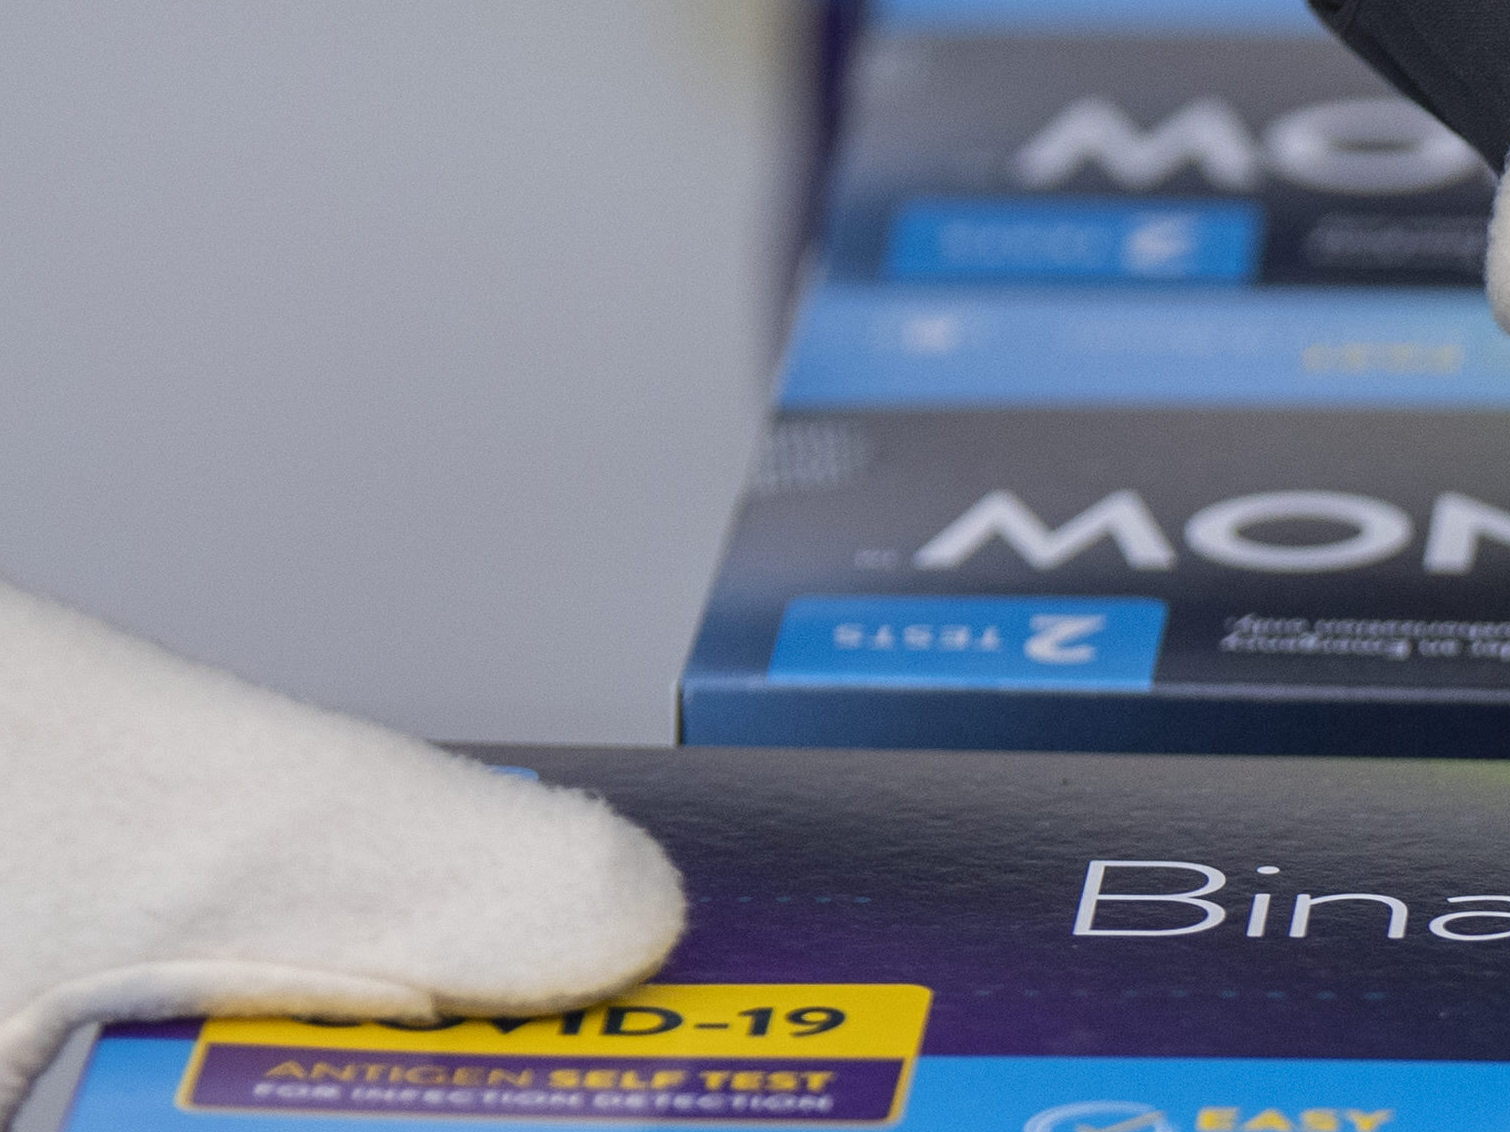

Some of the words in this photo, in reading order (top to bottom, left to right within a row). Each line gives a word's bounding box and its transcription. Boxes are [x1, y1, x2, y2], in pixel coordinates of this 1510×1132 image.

[1025, 614, 1105, 665] 2
[290, 1004, 848, 1038] ID-19
[264, 1060, 534, 1088] ANTIGEN
[550, 1068, 688, 1091] SELF
[702, 1070, 835, 1092] TEST
